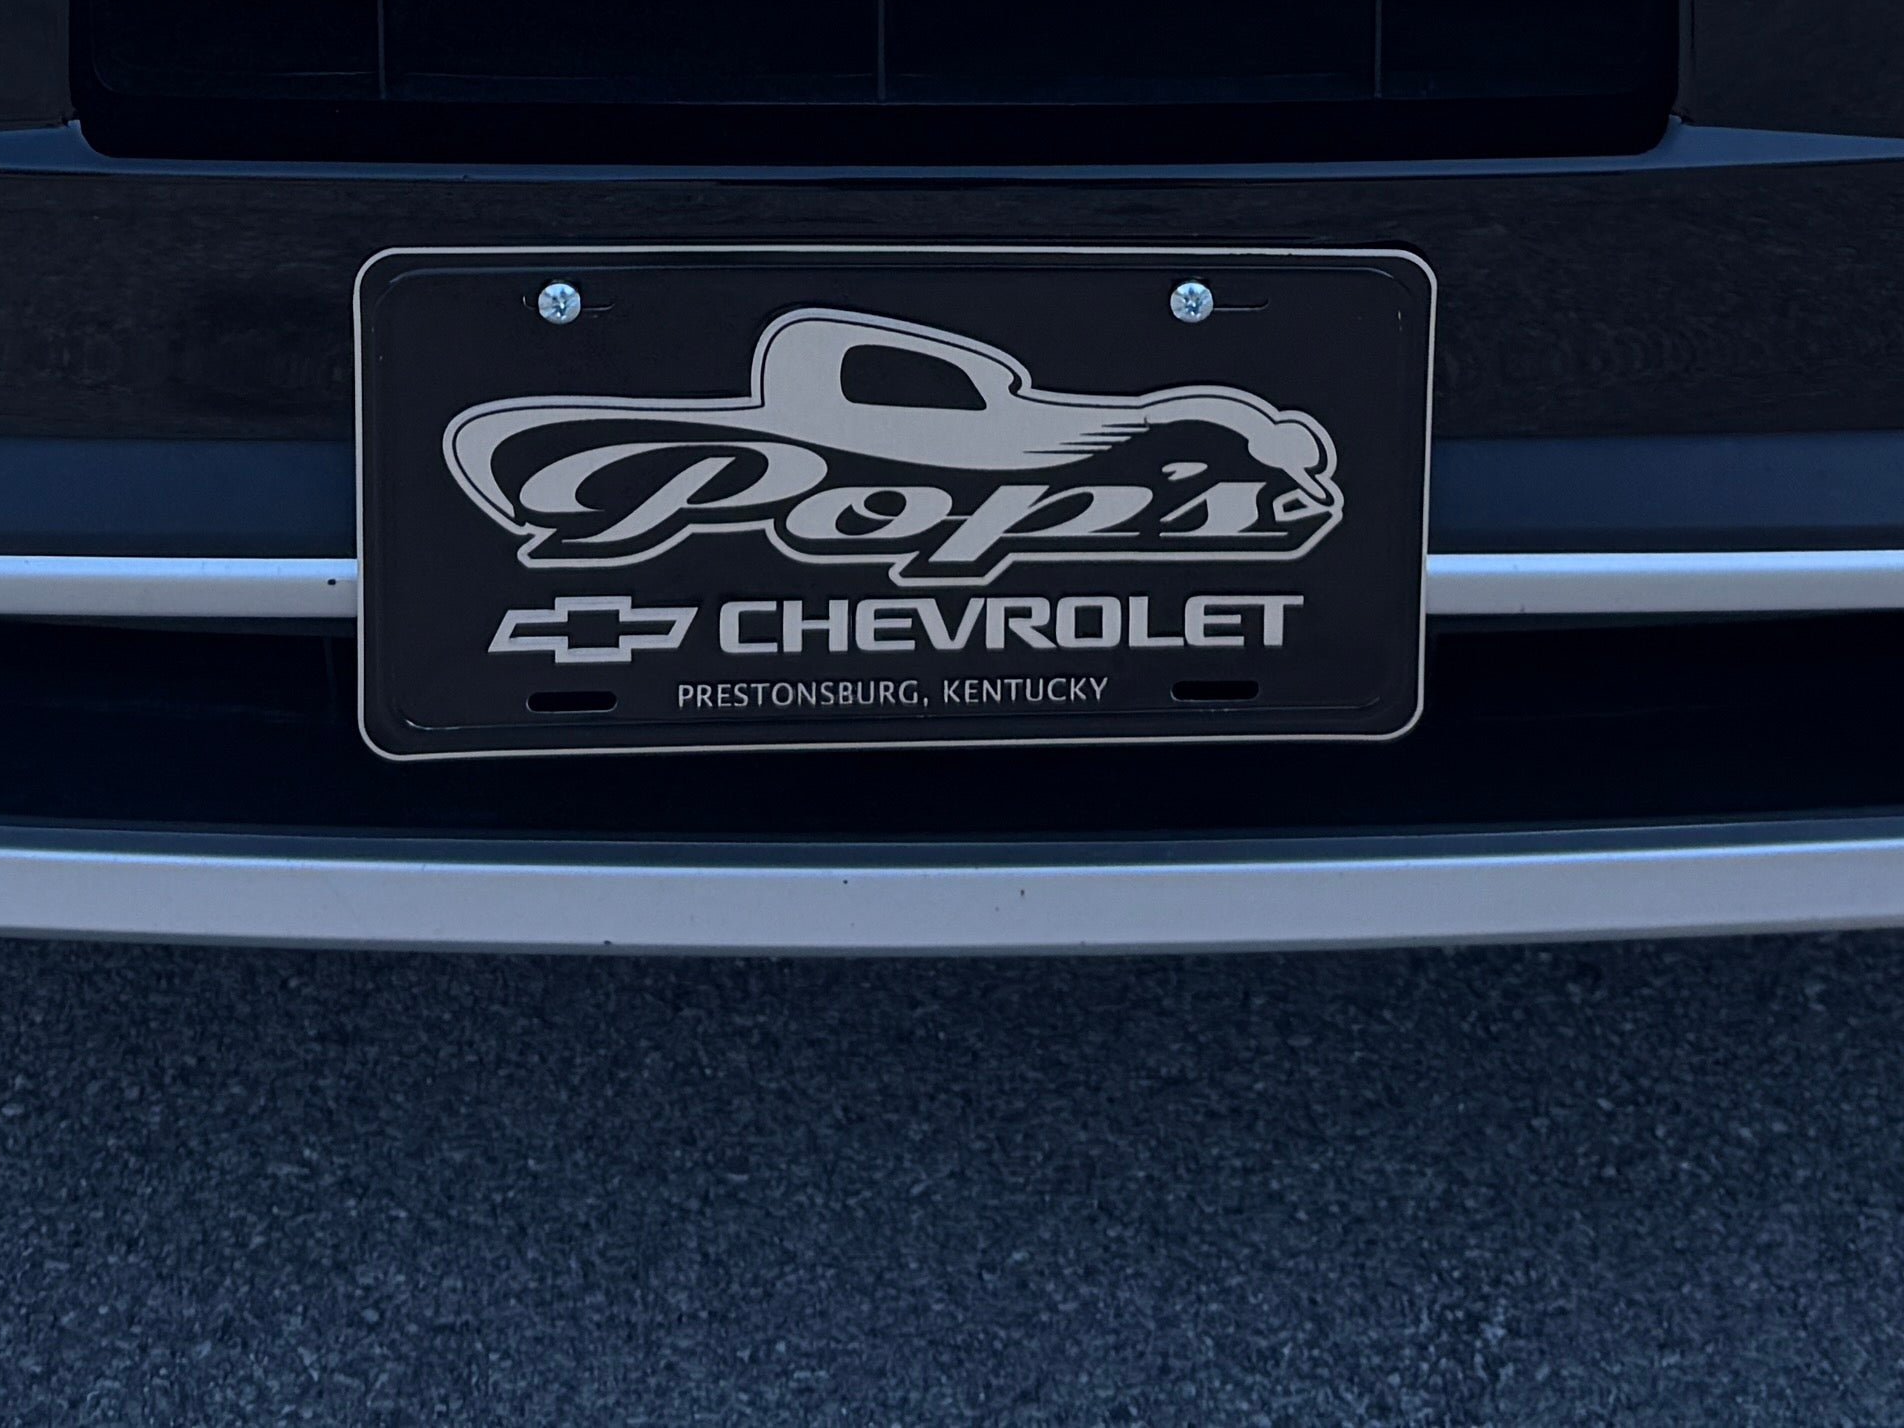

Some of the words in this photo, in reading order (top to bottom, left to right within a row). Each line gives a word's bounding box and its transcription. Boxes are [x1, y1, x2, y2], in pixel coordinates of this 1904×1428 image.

[519, 442, 1289, 563] Pop's
[718, 594, 1305, 653] CHEVROLET
[677, 680, 932, 710] PRESTONSBURG,
[943, 676, 1110, 705] KENTUCKY
